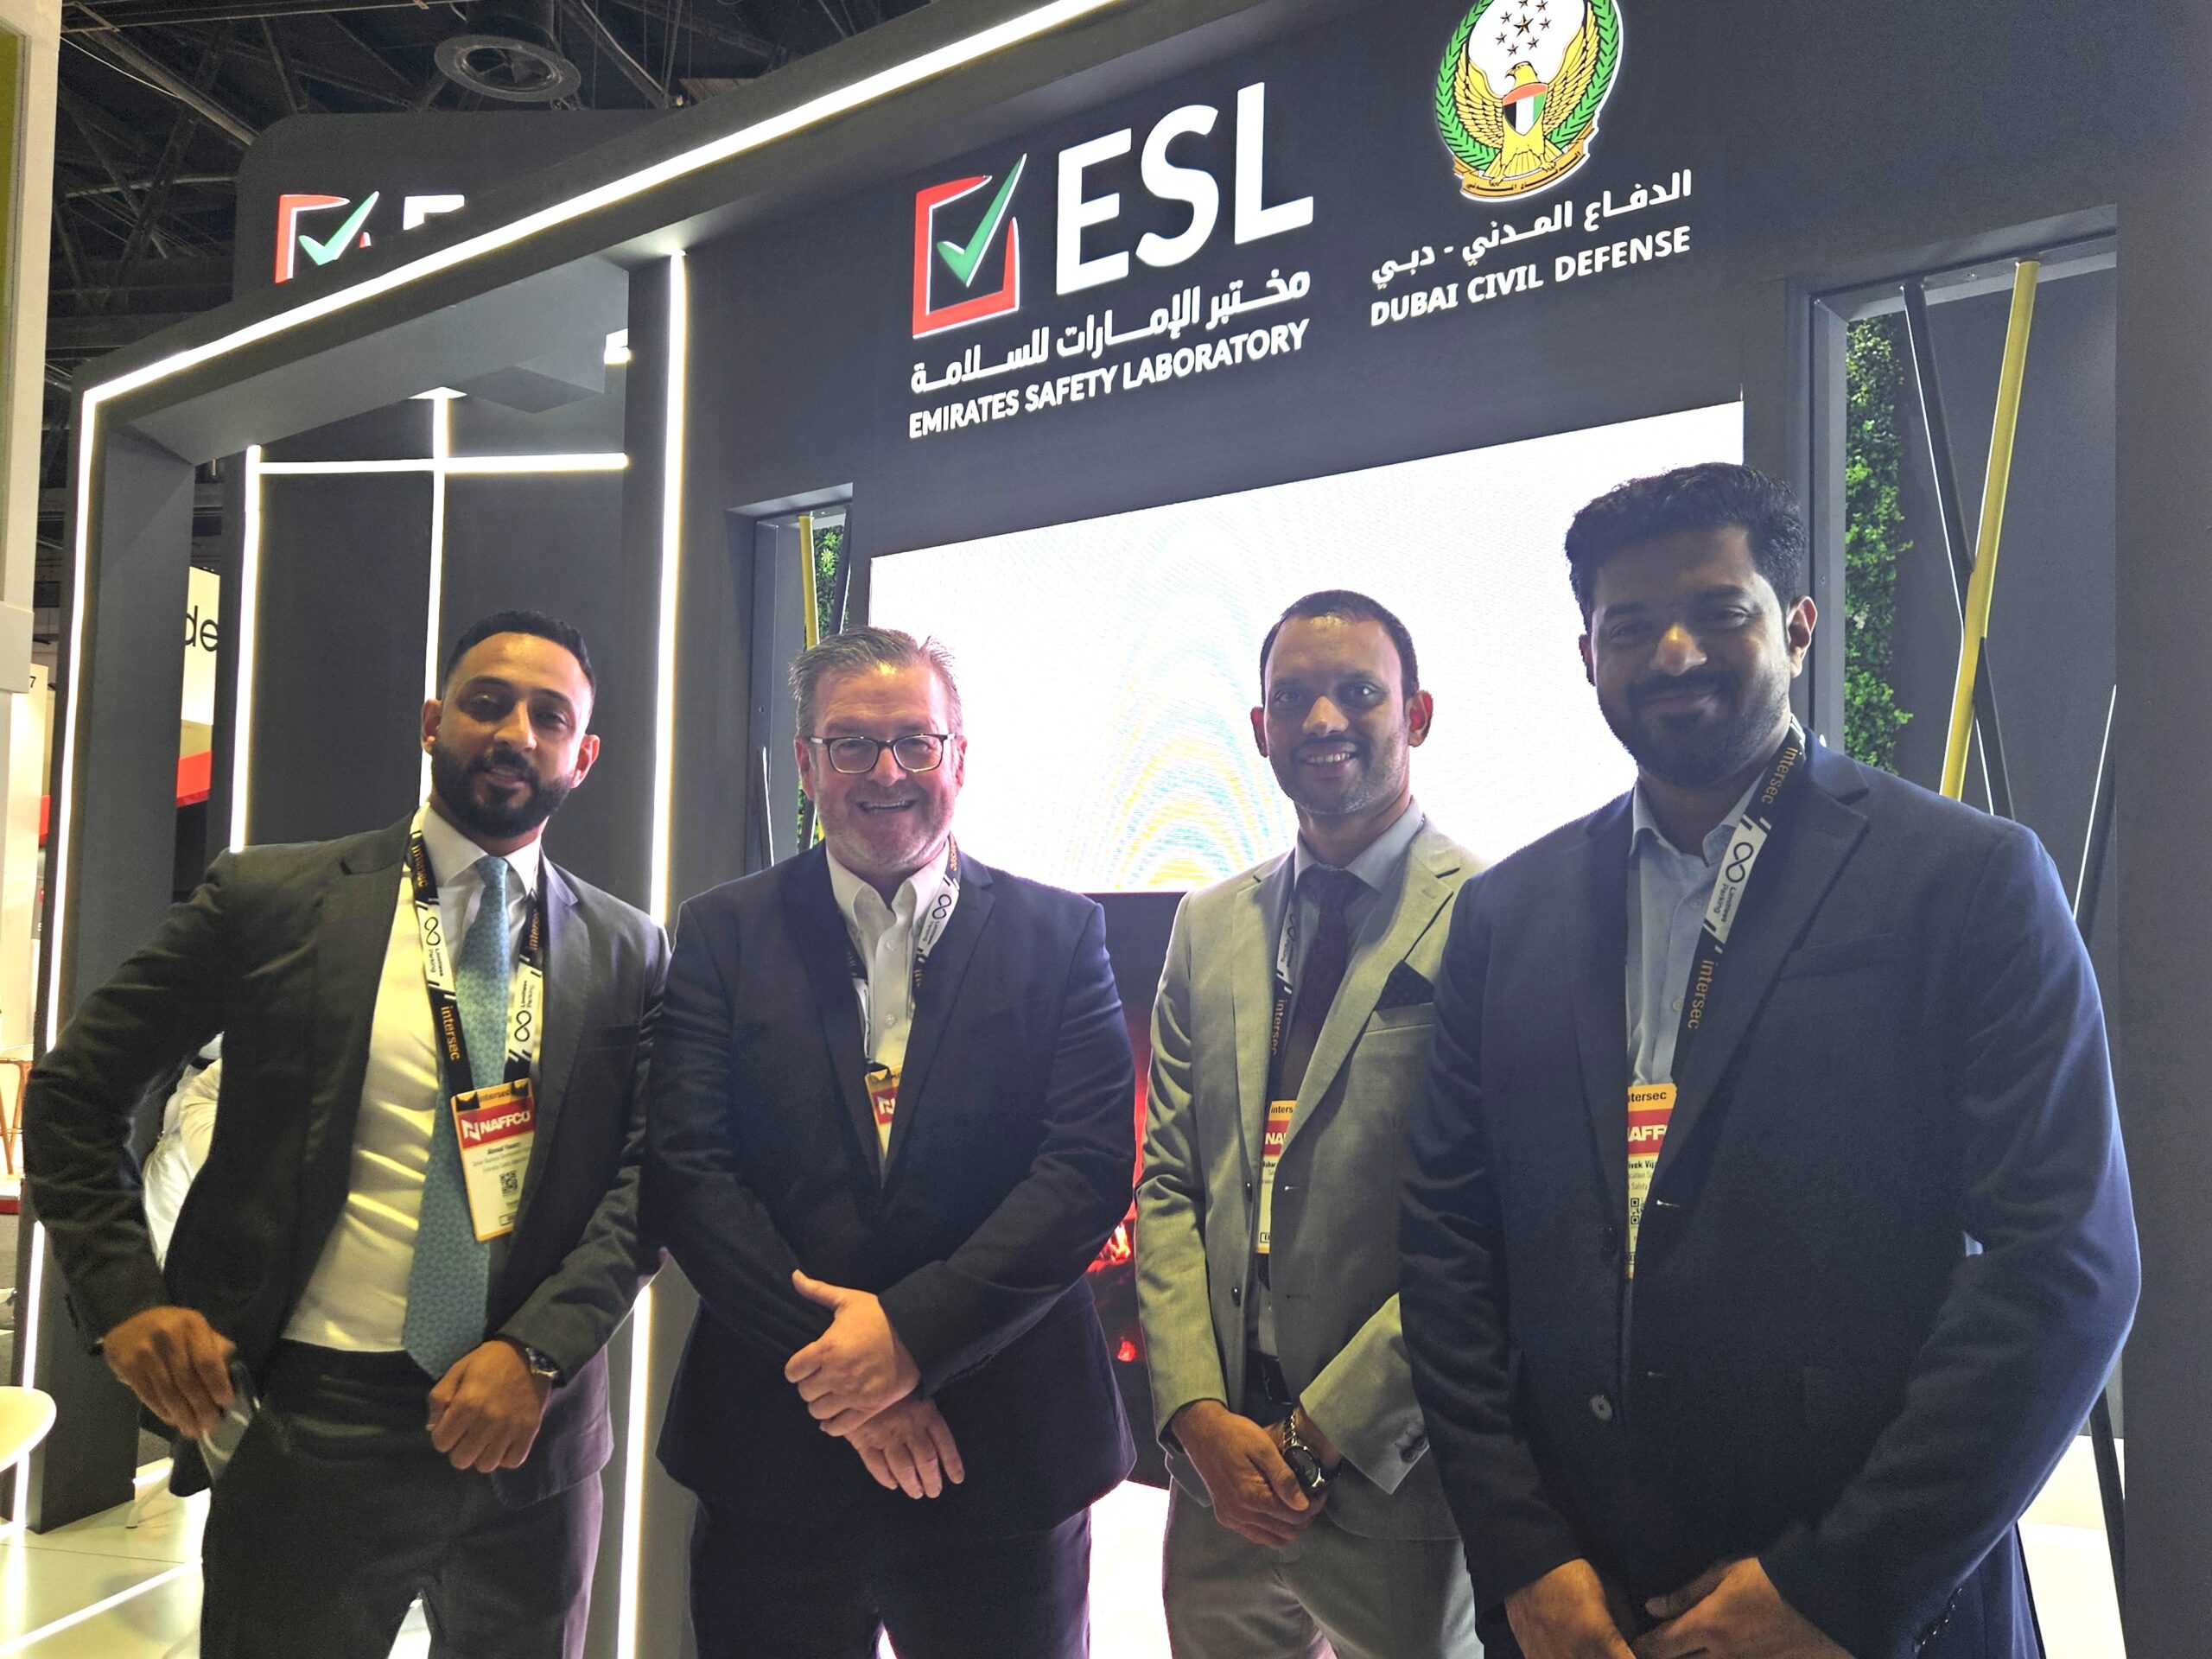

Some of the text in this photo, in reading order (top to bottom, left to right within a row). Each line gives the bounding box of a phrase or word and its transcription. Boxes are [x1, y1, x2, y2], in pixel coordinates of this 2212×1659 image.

[1056, 82, 1314, 295] ESL
[1584, 168, 1692, 232] الدفاع
[1462, 200, 1573, 267] المدني
[1370, 226, 1691, 327] DUBAI CIVIL DEFENSE
[1371, 246, 1435, 290] دبي
[1205, 269, 1311, 331] مختبر
[909, 318, 1311, 439] EMIRATES SAFETY LABORATORY
[911, 326, 1050, 394] للسلامة
[1761, 747, 1803, 804] intersec
[1688, 959, 1719, 1029] intersec
[441, 1006, 461, 1061] intersec
[1271, 999, 1287, 1056] intersec
[480, 1111, 531, 1134] NAFFCO
[1628, 1124, 1668, 1142] AFF
